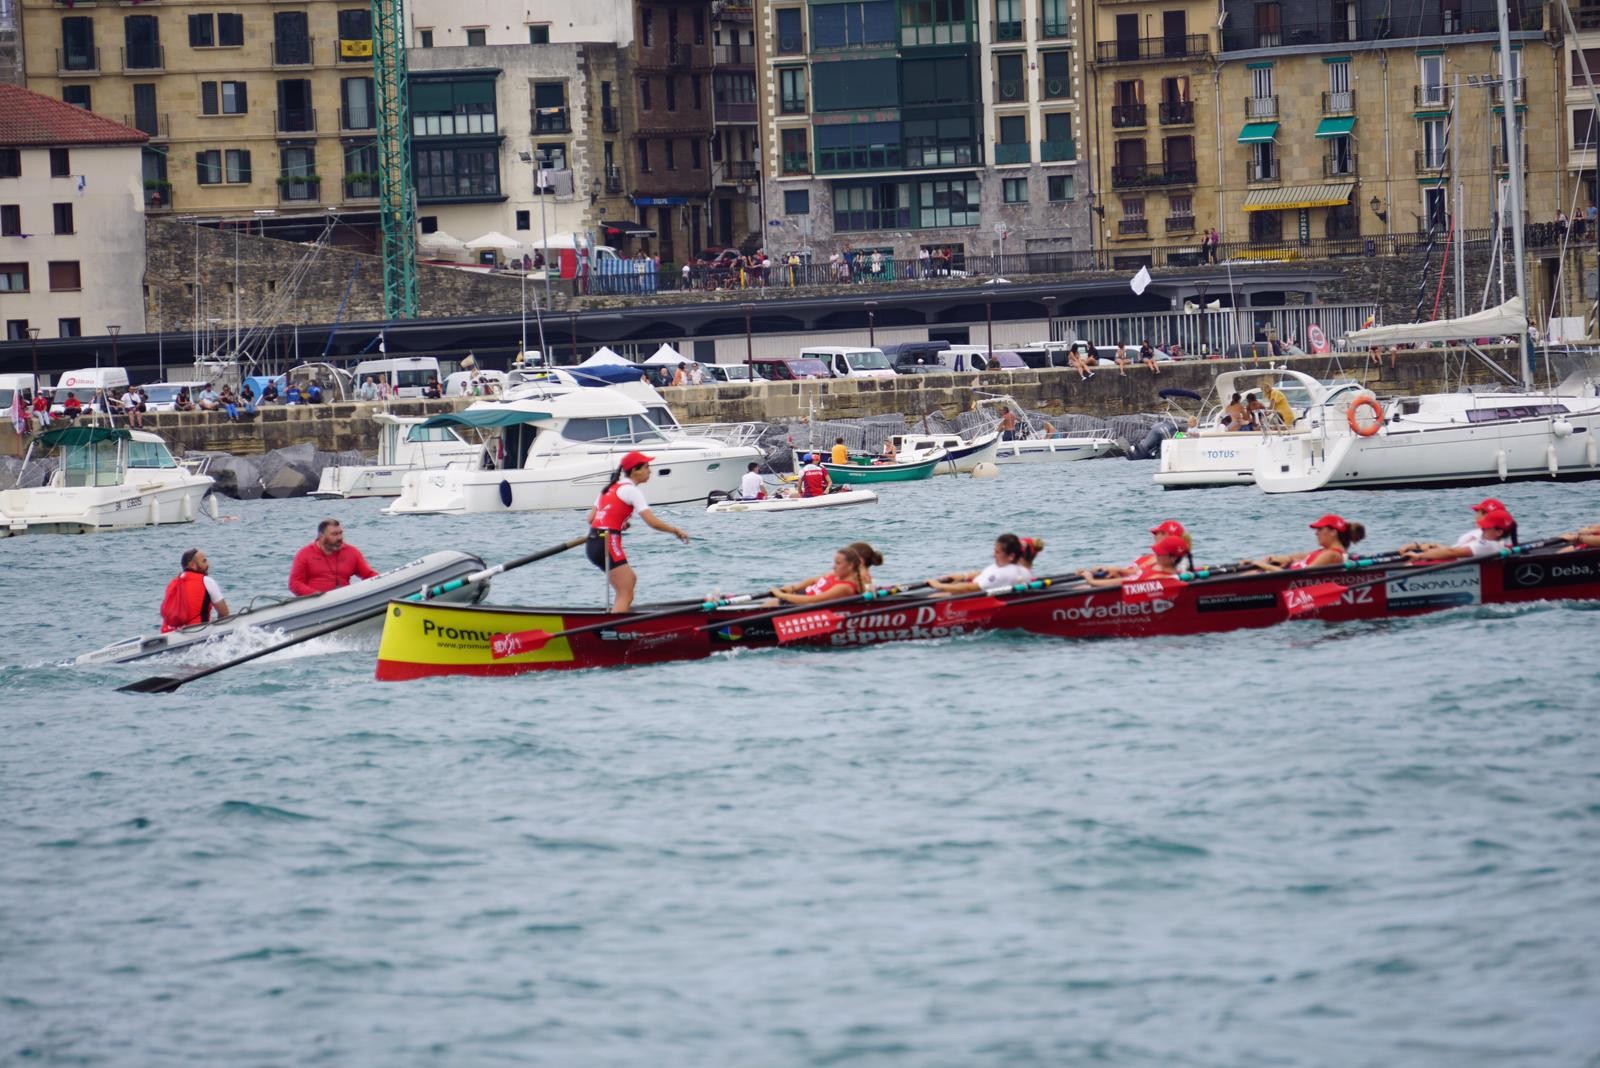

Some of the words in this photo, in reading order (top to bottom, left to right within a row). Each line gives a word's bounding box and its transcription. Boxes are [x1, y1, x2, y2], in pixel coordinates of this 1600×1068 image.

[1207, 450, 1235, 459] TOTUS
[1340, 586, 1374, 605] NZ
[1052, 595, 1152, 621] novadiet
[780, 621, 831, 635] TABERNA
